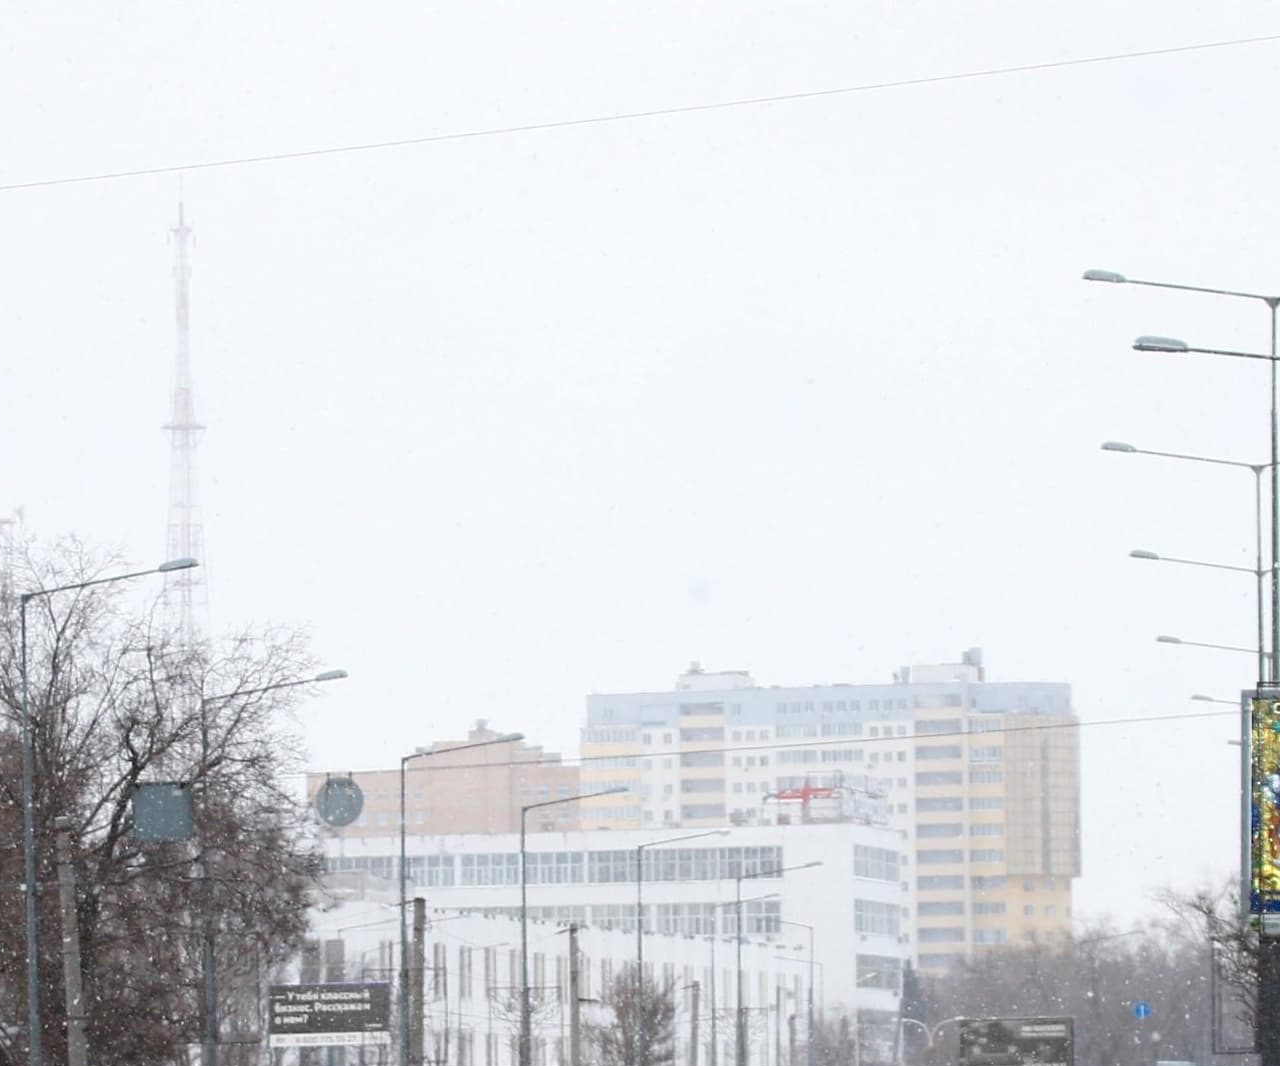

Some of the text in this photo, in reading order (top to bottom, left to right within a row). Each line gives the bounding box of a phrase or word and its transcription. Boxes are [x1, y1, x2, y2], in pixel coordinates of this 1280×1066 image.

[320, 988, 370, 1000] классный
[274, 1001, 371, 1013] бизнес. Расскажем
